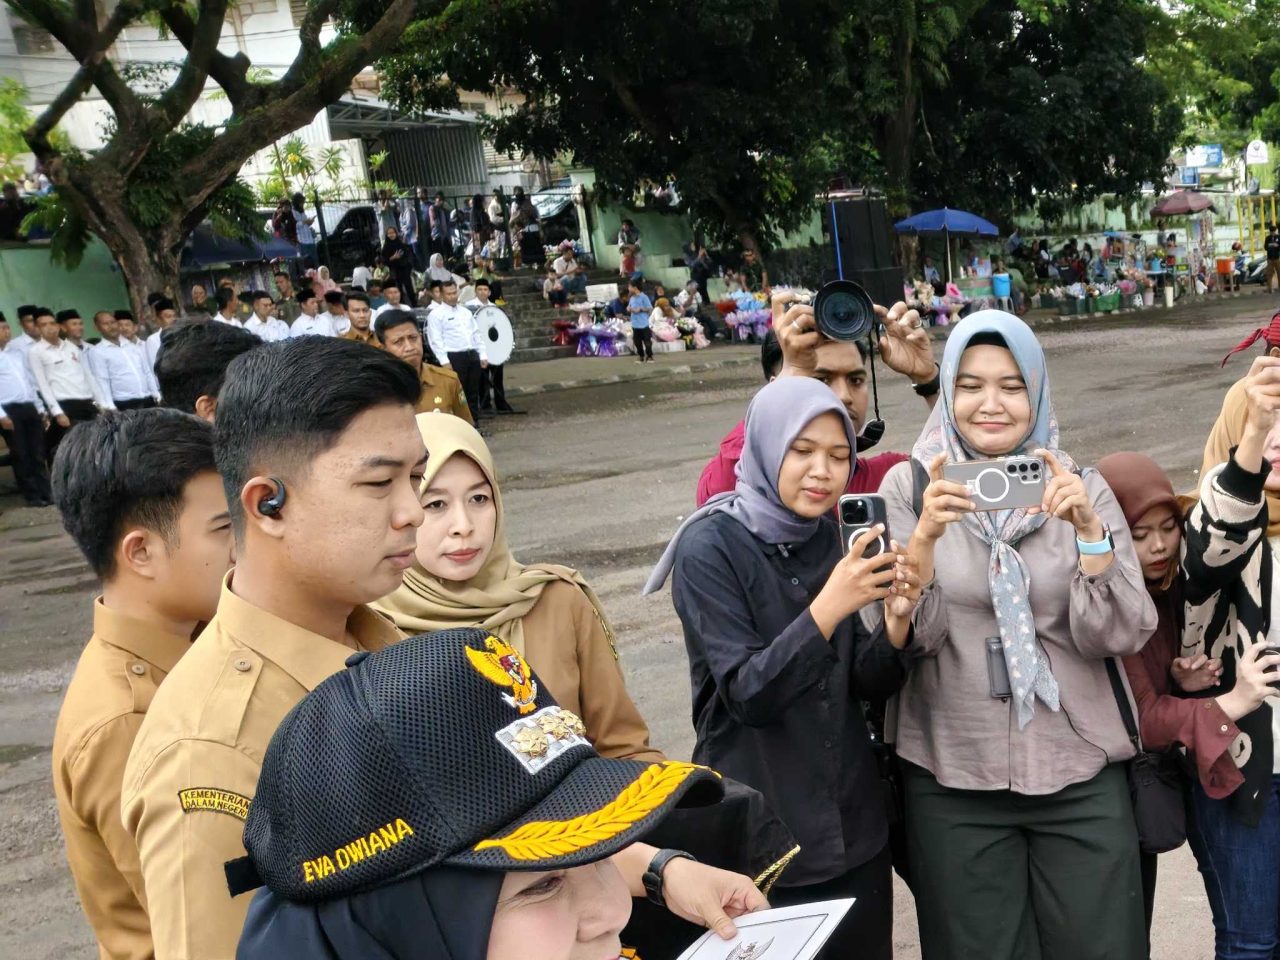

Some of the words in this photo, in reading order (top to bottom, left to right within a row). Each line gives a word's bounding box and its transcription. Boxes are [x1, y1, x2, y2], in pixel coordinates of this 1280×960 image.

[184, 790, 249, 810] KEMENTERIAN
[185, 799, 216, 809] DALAM
[217, 801, 247, 818] NEGERI
[303, 855, 336, 882] EVA
